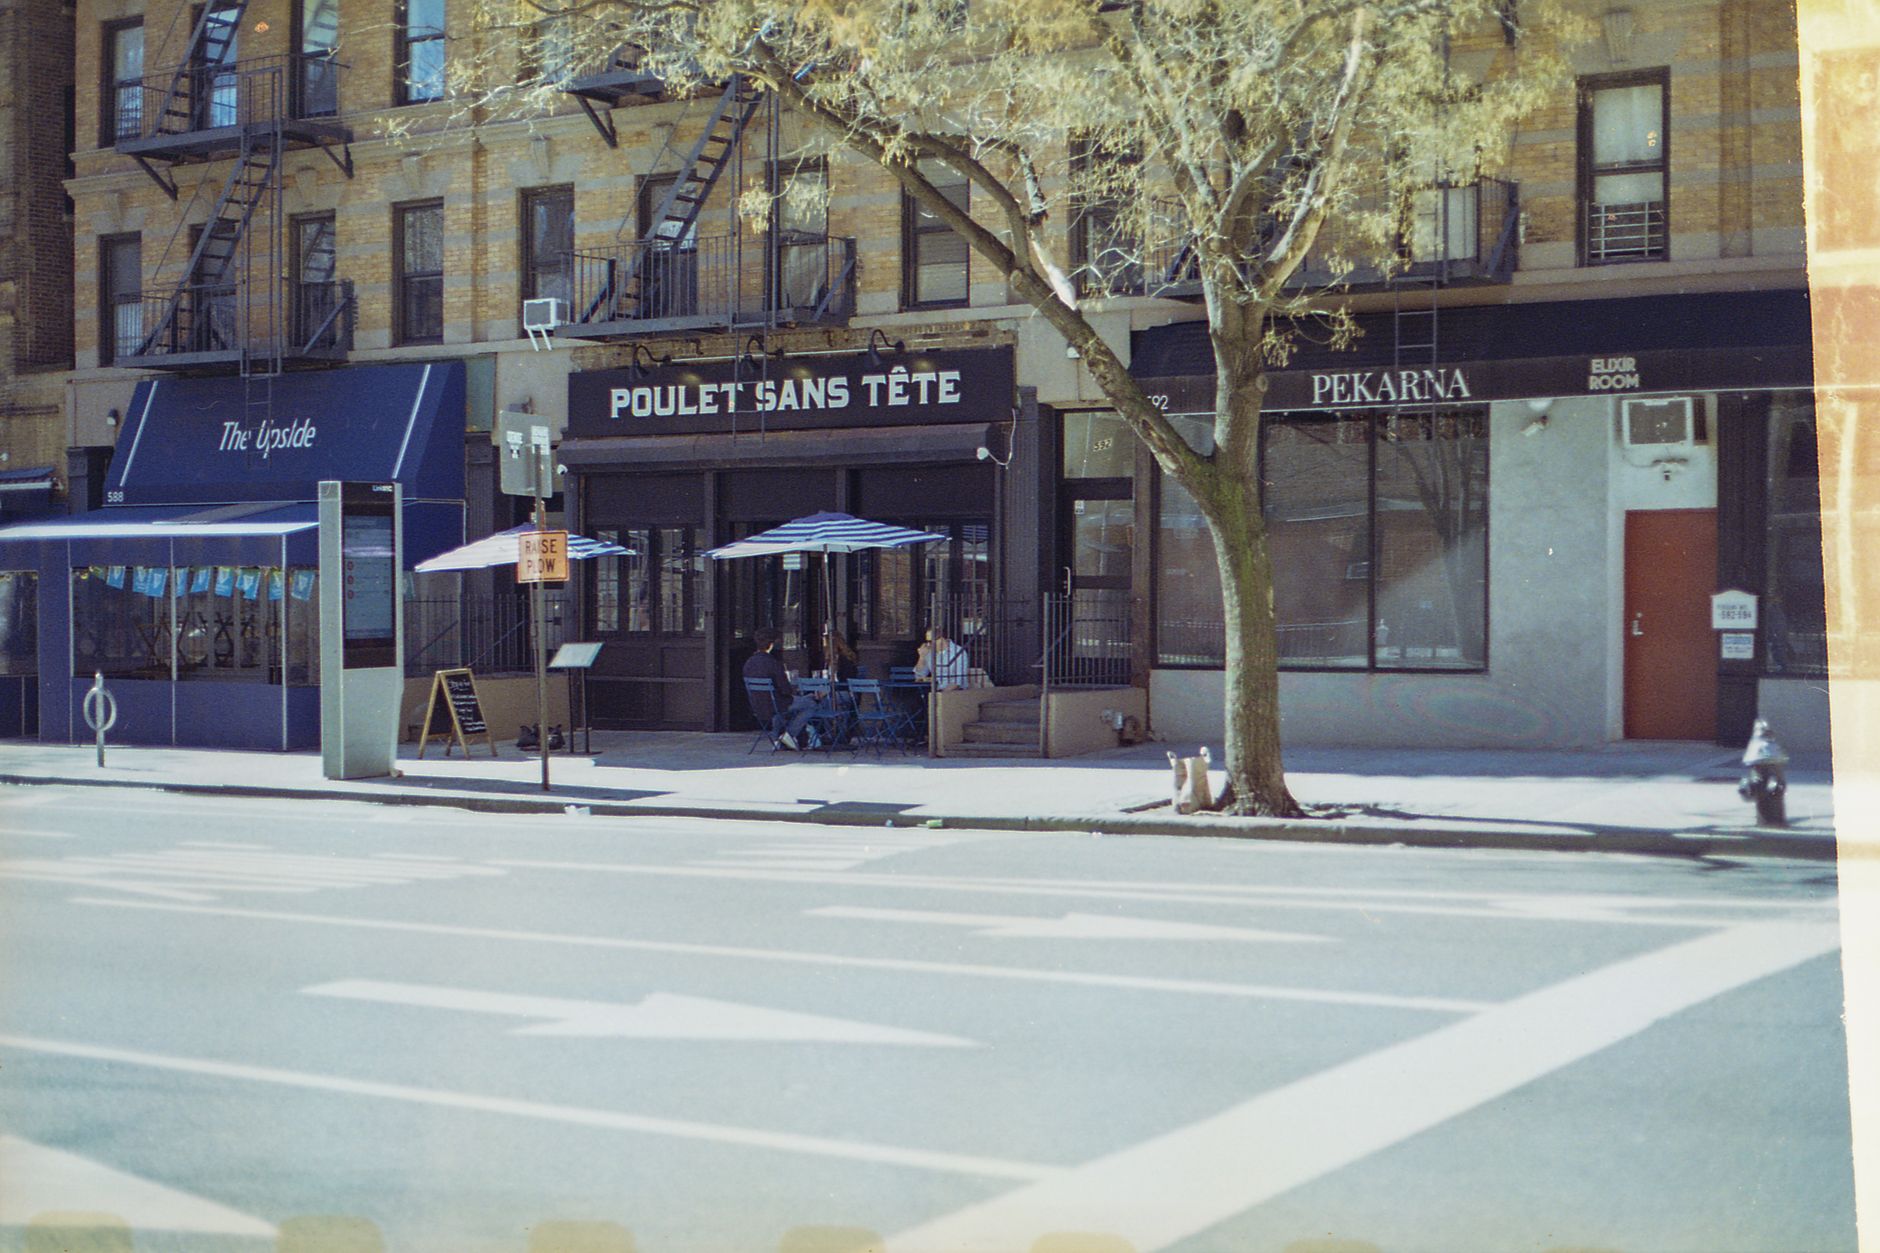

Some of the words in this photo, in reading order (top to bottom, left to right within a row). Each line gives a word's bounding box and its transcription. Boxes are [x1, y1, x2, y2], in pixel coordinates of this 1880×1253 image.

[1591, 357, 1637, 373] ELIXIR
[1312, 368, 1471, 405] PEKARNA
[1589, 373, 1640, 390] ROOM
[610, 383, 744, 419] POULET
[755, 375, 849, 412] SANS
[861, 365, 961, 407] TÊTE
[1147, 395, 1169, 410] 92
[219, 421, 252, 451] The
[256, 418, 316, 459] Upside
[107, 491, 124, 503] 588
[525, 538, 558, 555] RASE
[526, 558, 556, 574] POW
